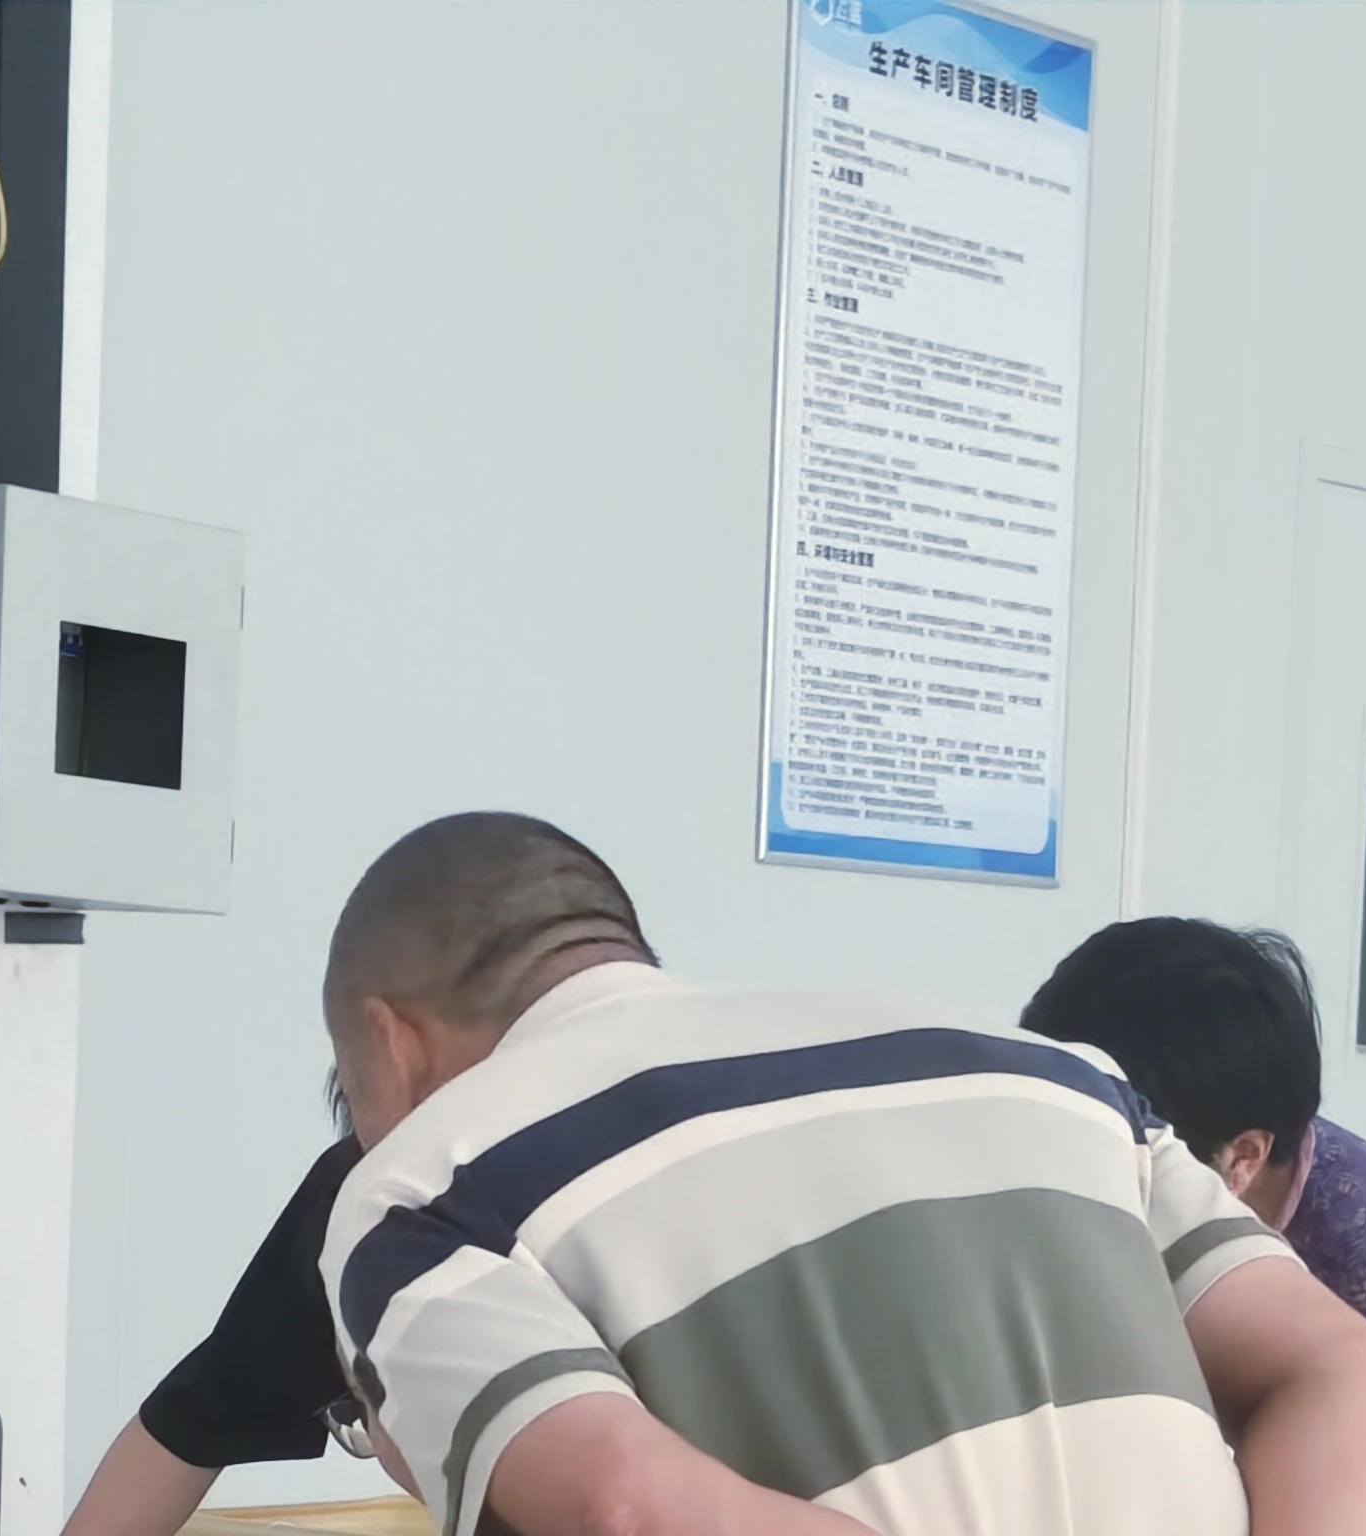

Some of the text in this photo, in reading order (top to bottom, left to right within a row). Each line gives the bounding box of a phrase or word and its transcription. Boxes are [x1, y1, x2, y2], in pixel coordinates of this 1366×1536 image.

[869, 41, 1038, 122] 生产车间管理制度
